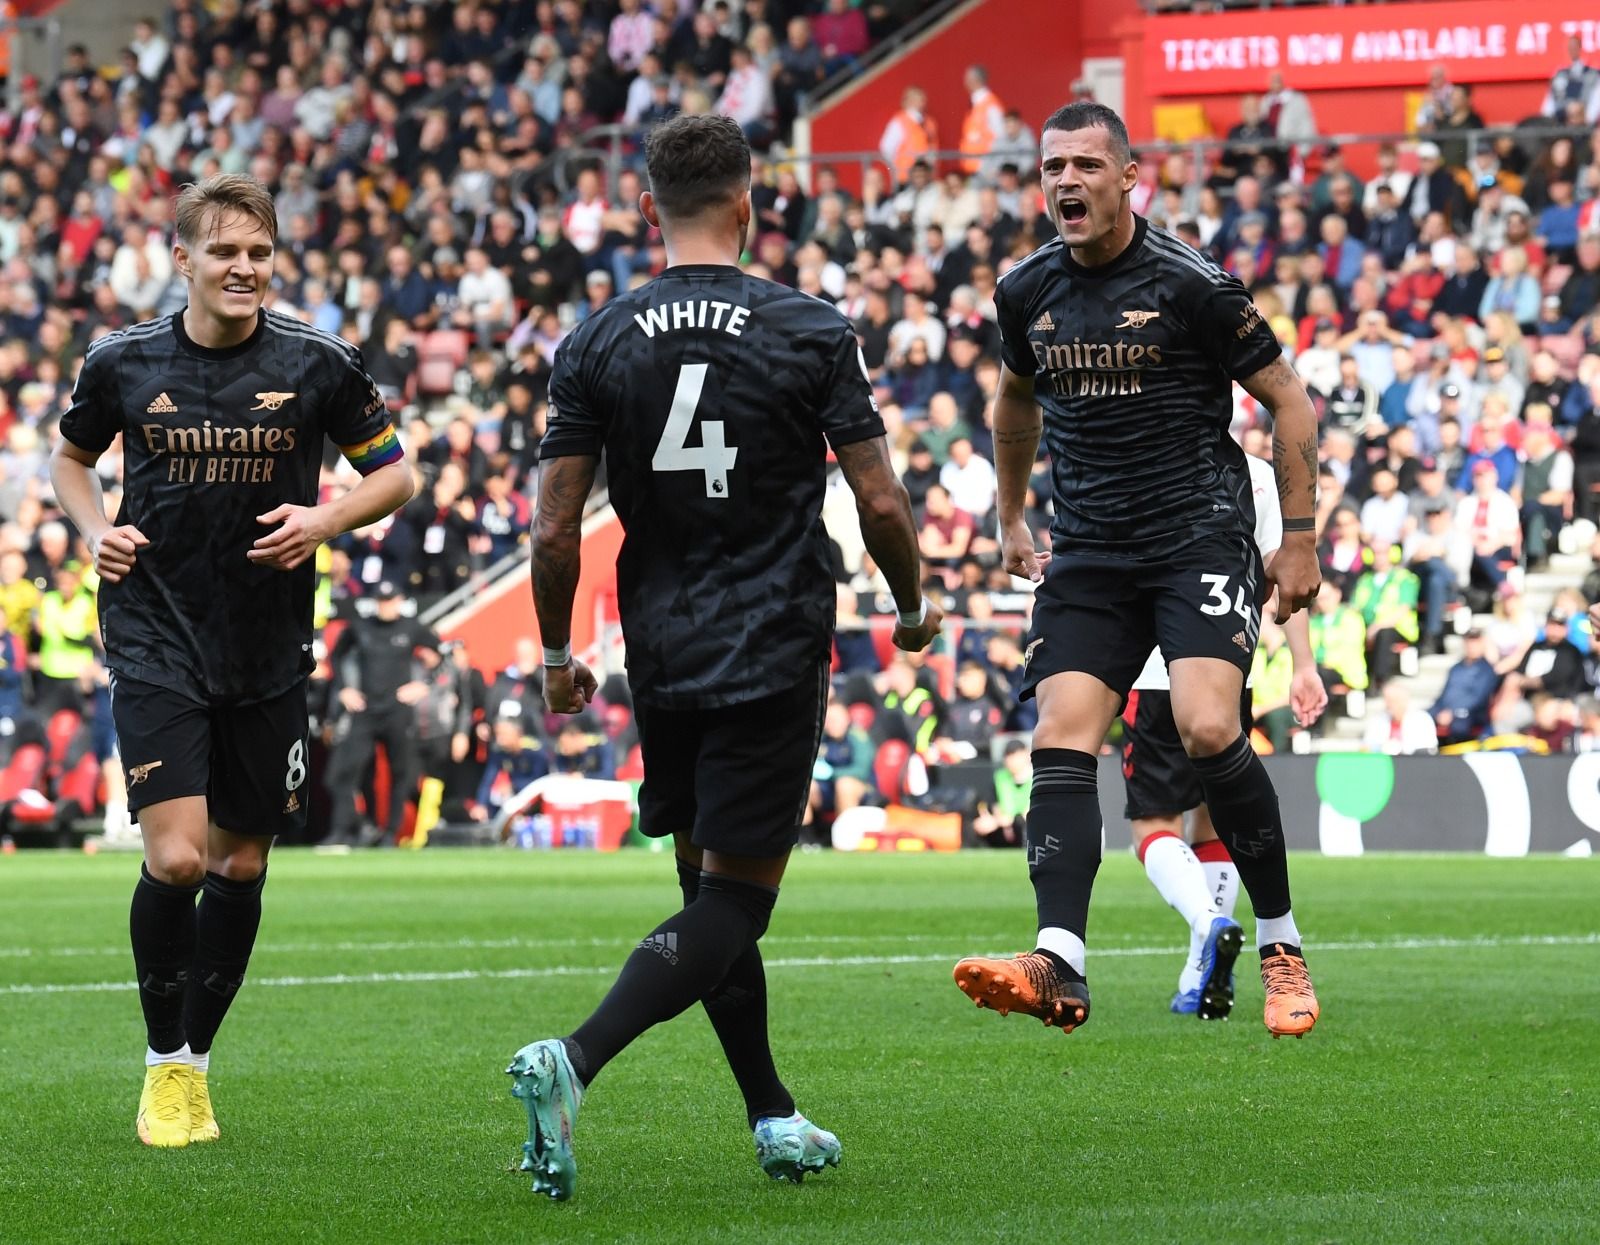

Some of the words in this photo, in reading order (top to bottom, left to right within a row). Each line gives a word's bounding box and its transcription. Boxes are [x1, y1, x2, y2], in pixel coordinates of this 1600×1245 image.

[1162, 36, 1280, 72] TICKETS
[1287, 33, 1343, 66] NOW
[1352, 24, 1506, 63] AVAILABLE
[1516, 22, 1551, 55] AT
[1561, 20, 1600, 53] TI
[633, 300, 751, 338] WHITE
[1033, 323, 1056, 331] adidas
[1030, 336, 1162, 370] Emirates
[1079, 371, 1142, 397] BETTER
[146, 404, 178, 413] adidas
[141, 420, 296, 453] Emirates
[652, 363, 738, 498] 4
[168, 457, 199, 482] FLY
[205, 457, 275, 483] BETTER
[1200, 573, 1251, 633] 34
[285, 738, 306, 791] 8
